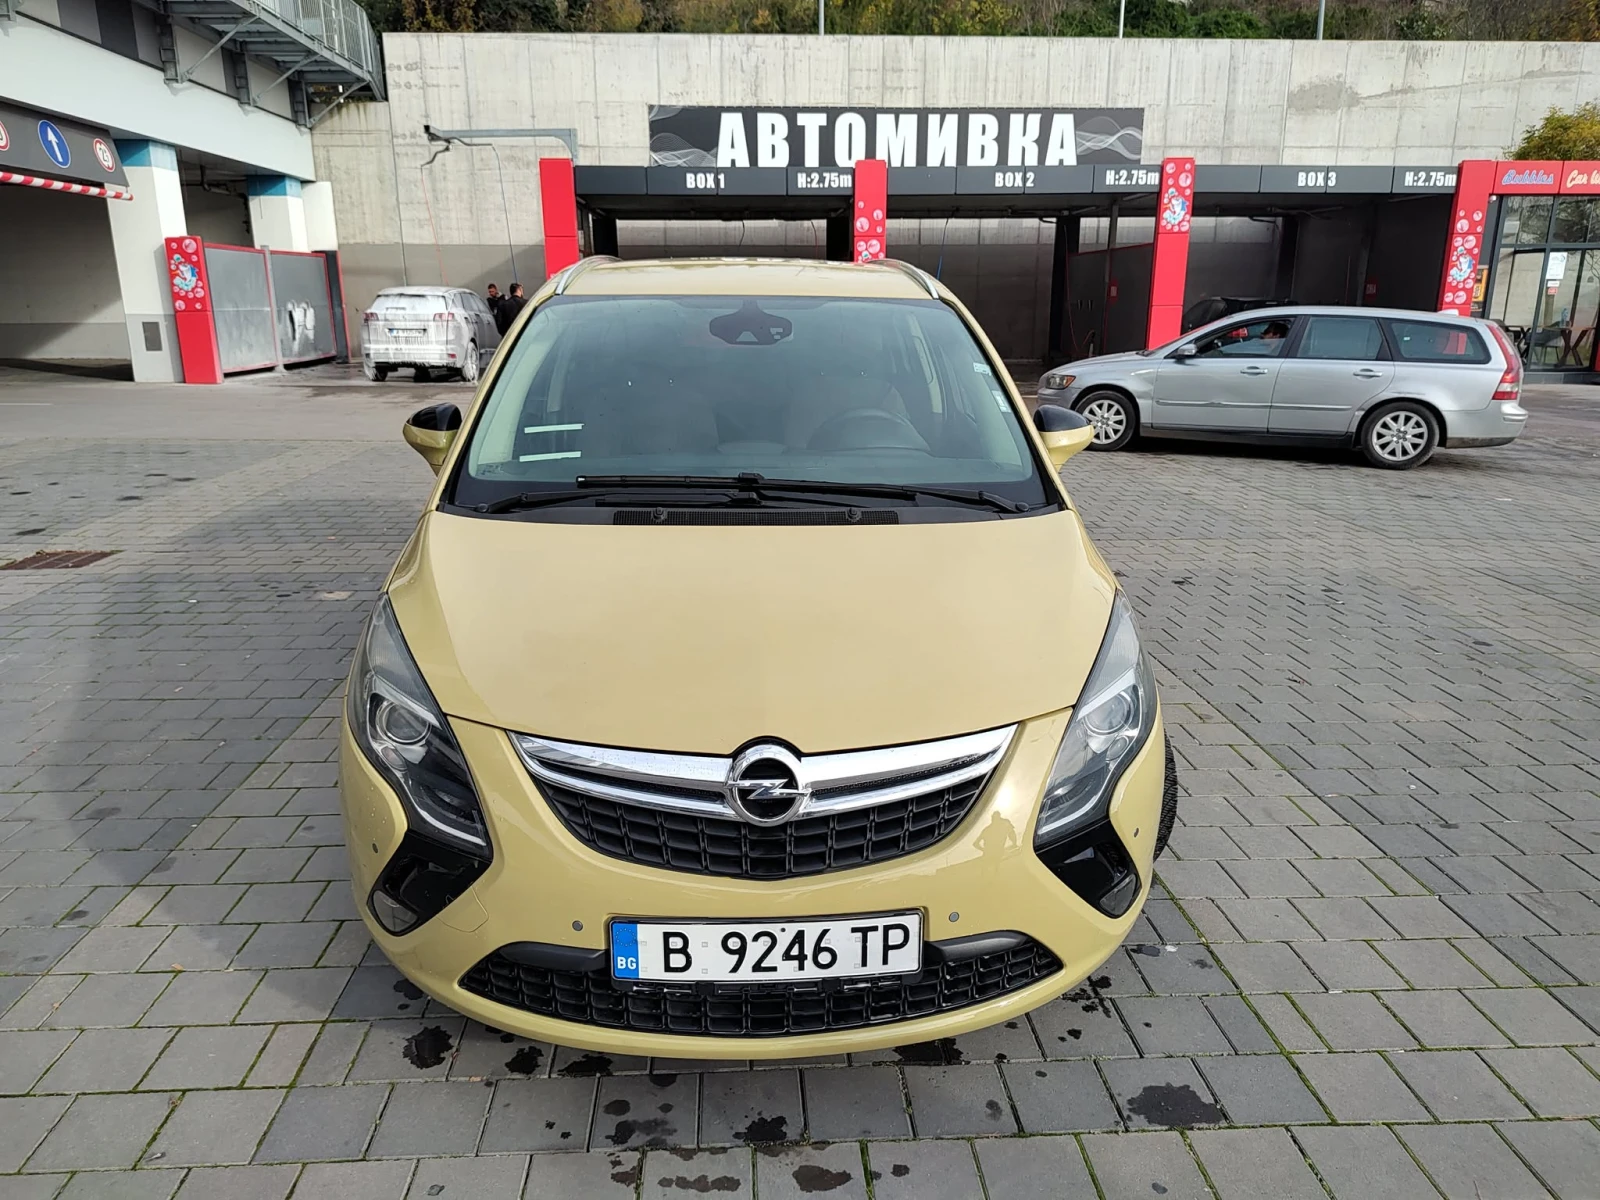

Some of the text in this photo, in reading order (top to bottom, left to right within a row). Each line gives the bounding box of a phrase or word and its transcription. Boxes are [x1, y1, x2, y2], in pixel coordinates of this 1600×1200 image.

[717, 112, 1077, 168] АВТОМИВКА
[686, 172, 725, 189] BOX 1
[797, 172, 852, 189] H:2.75m
[995, 171, 1035, 188] BOX 2
[1105, 169, 1159, 186] H:2.75m
[1297, 171, 1337, 187] BOX 3
[1404, 171, 1457, 187] H:2.75m
[1501, 169, 1554, 185] Bubbles
[1566, 169, 1589, 188] Car
[662, 923, 910, 974] B 9246 TP
[617, 956, 637, 970] BG
